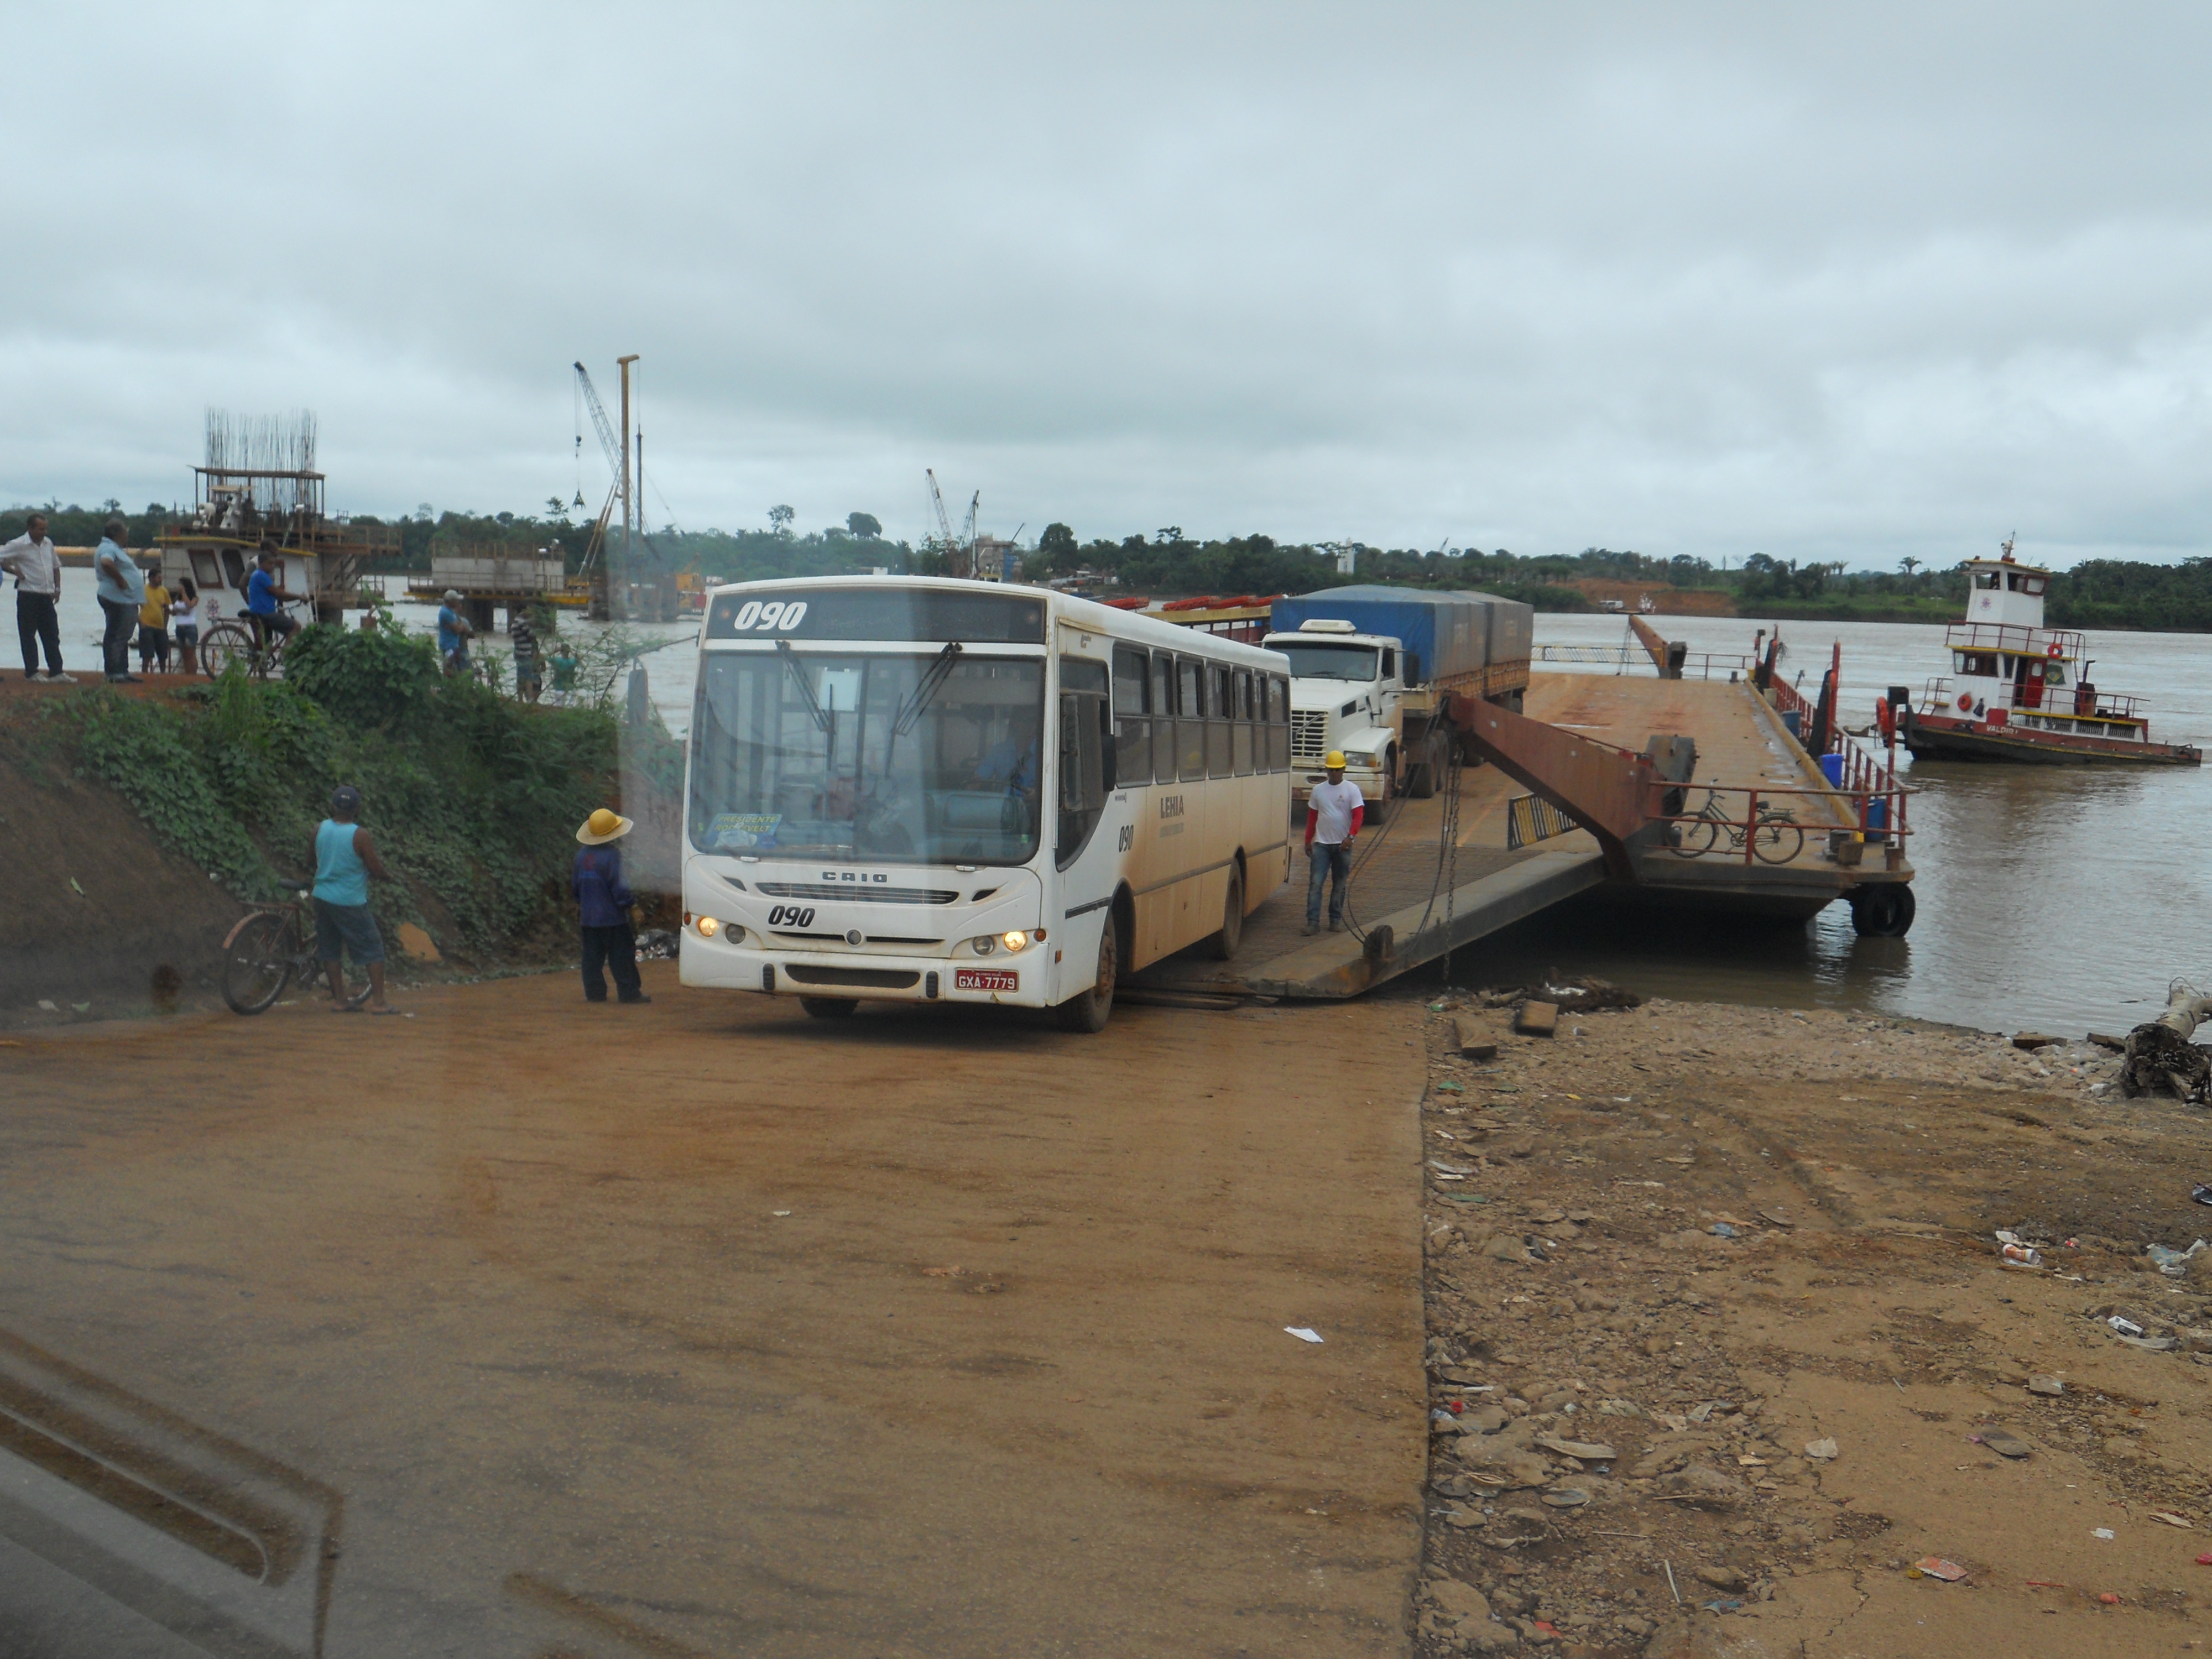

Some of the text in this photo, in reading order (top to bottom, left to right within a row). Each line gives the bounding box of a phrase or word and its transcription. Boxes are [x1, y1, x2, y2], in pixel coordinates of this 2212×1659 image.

[734, 601, 807, 630] 090
[715, 824, 771, 832] ROOEVELT
[1119, 825, 1134, 853] 090
[822, 872, 888, 883] CAIO
[768, 905, 816, 927] 090
